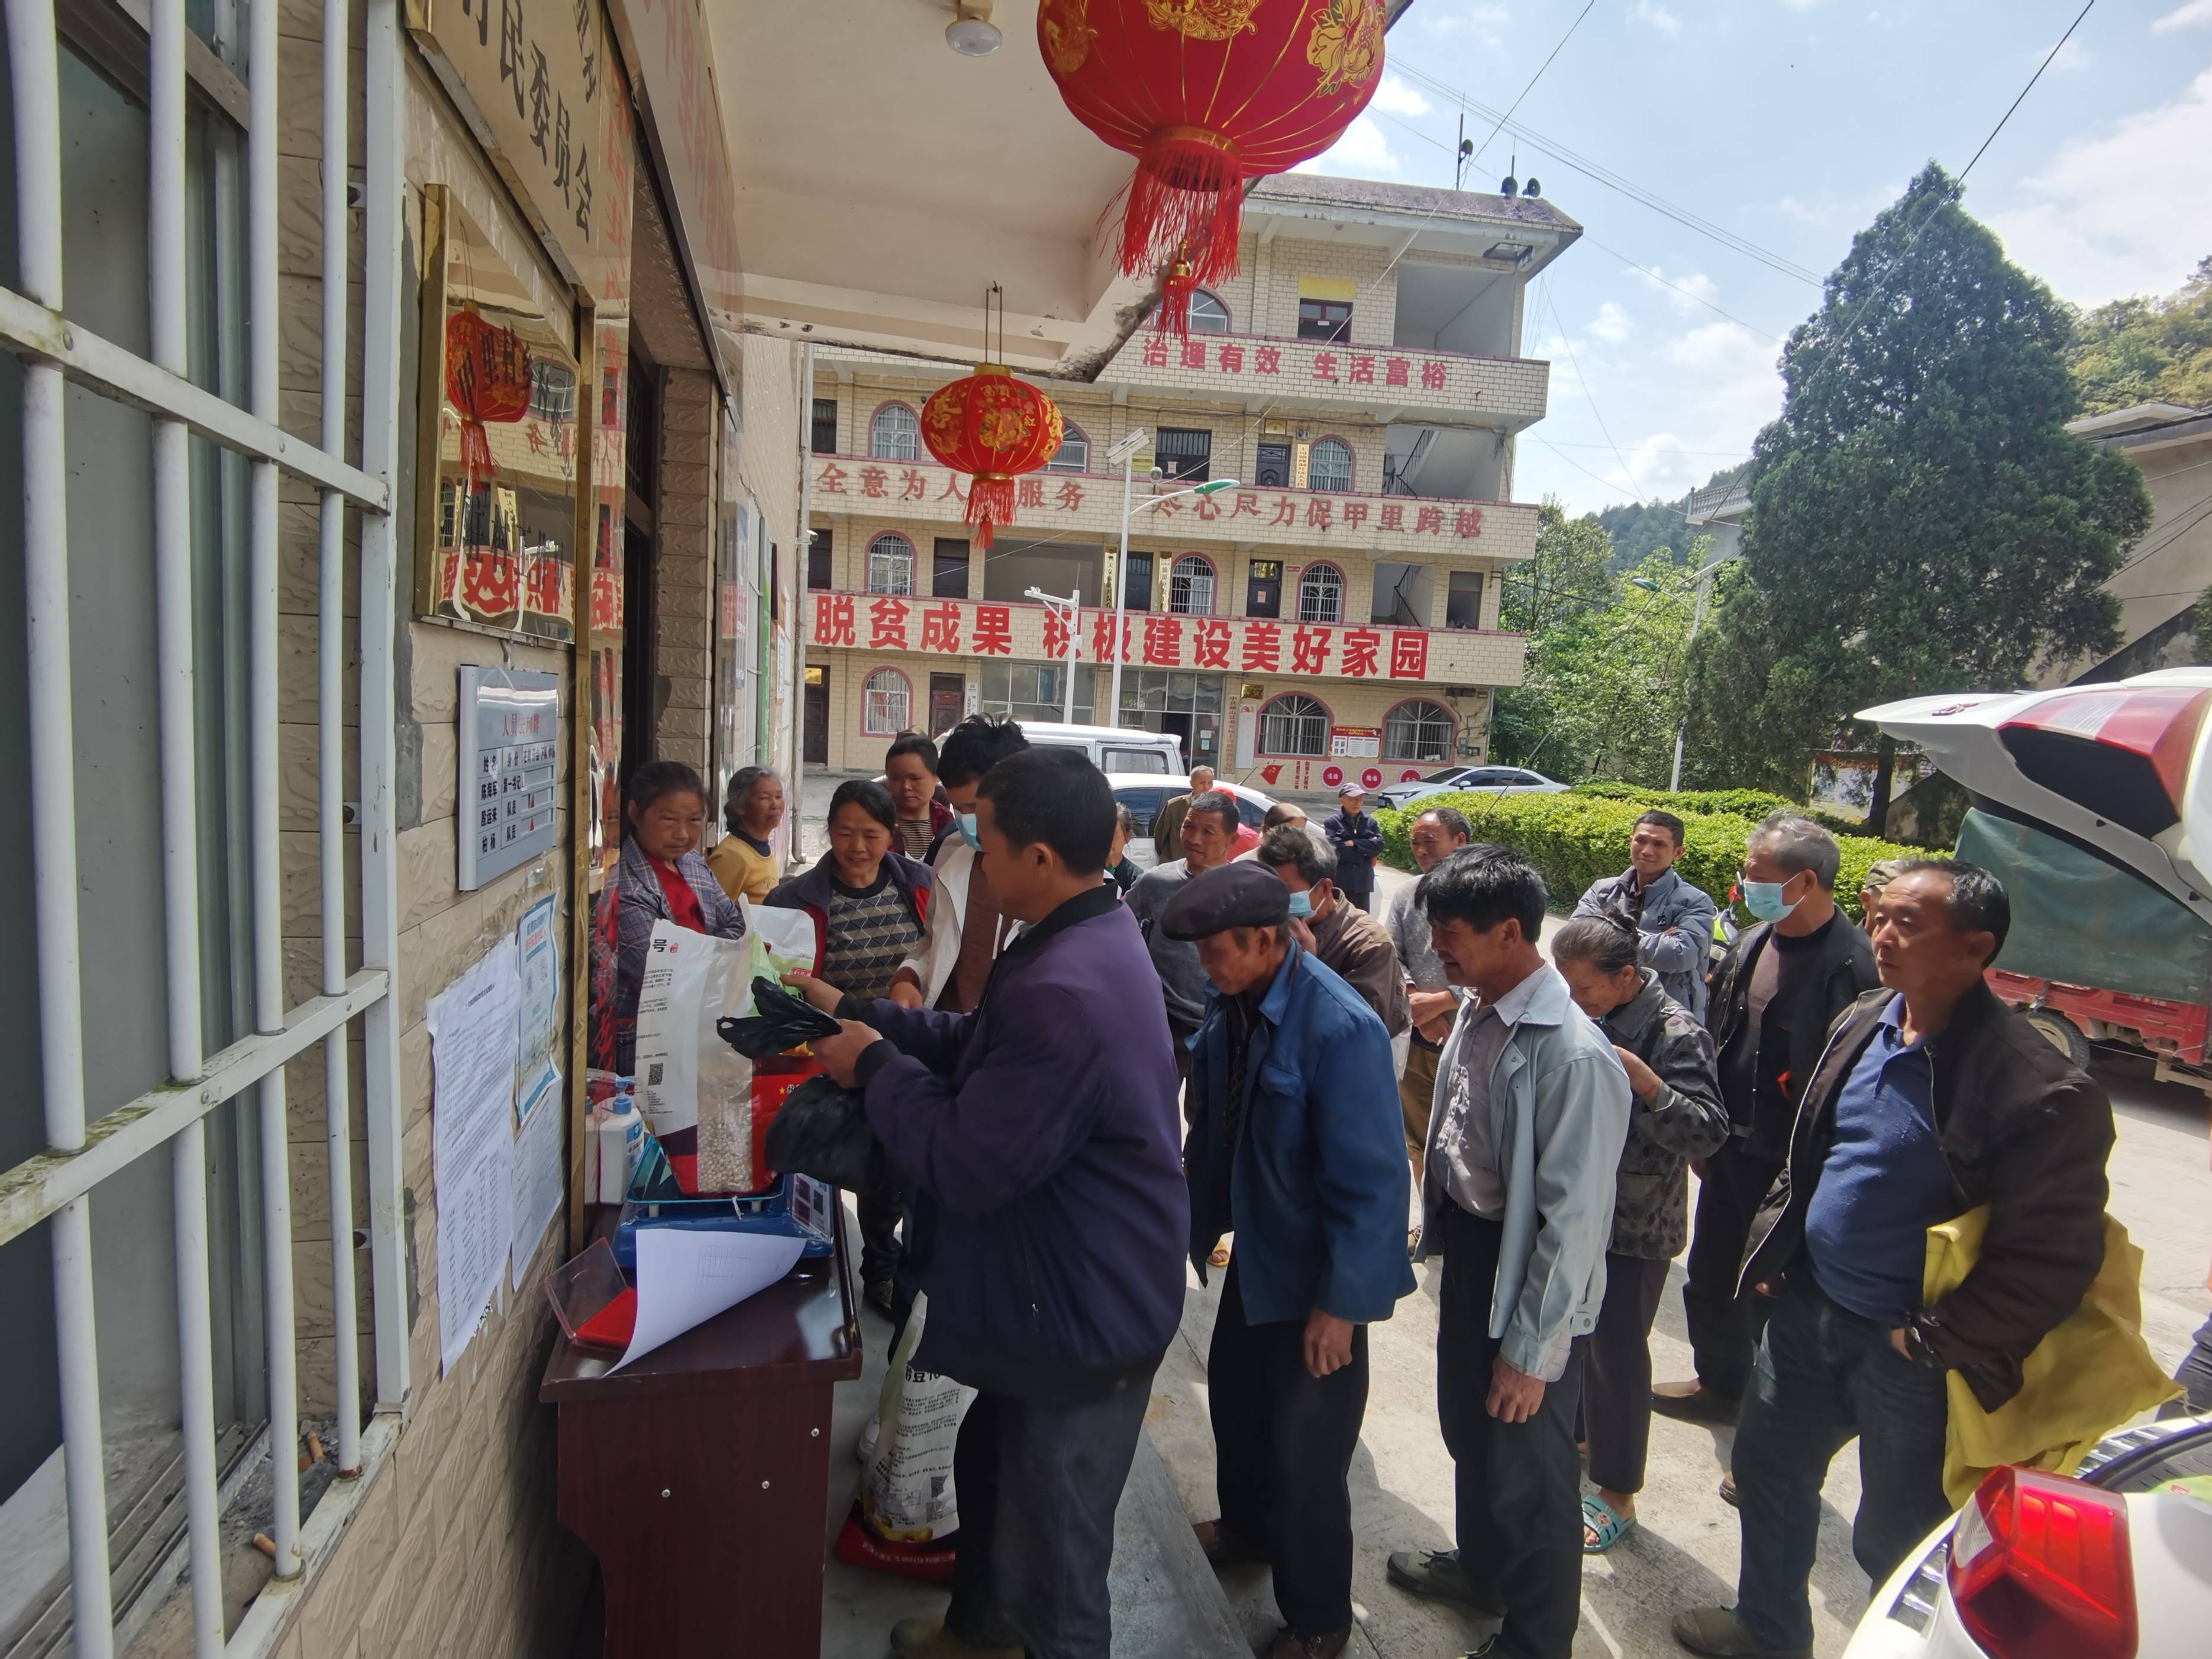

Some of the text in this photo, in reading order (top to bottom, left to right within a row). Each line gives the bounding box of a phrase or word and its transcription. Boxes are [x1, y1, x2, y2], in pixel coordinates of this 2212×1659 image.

[1142, 337, 1446, 389] 治理有效 生活富裕
[818, 463, 1086, 512] 全意为人服务
[1152, 488, 1482, 538] 尽心尽力促甲里跨越
[813, 594, 1429, 680] 脱贫成果 积极建设美好家园
[502, 712, 540, 737] 人员去向牌
[483, 754, 497, 773] 姓名
[506, 751, 519, 768] 身份
[502, 775, 521, 794] 第一书记
[506, 799, 517, 817] 队员
[506, 824, 516, 842] 队员
[652, 938, 668, 953] 号
